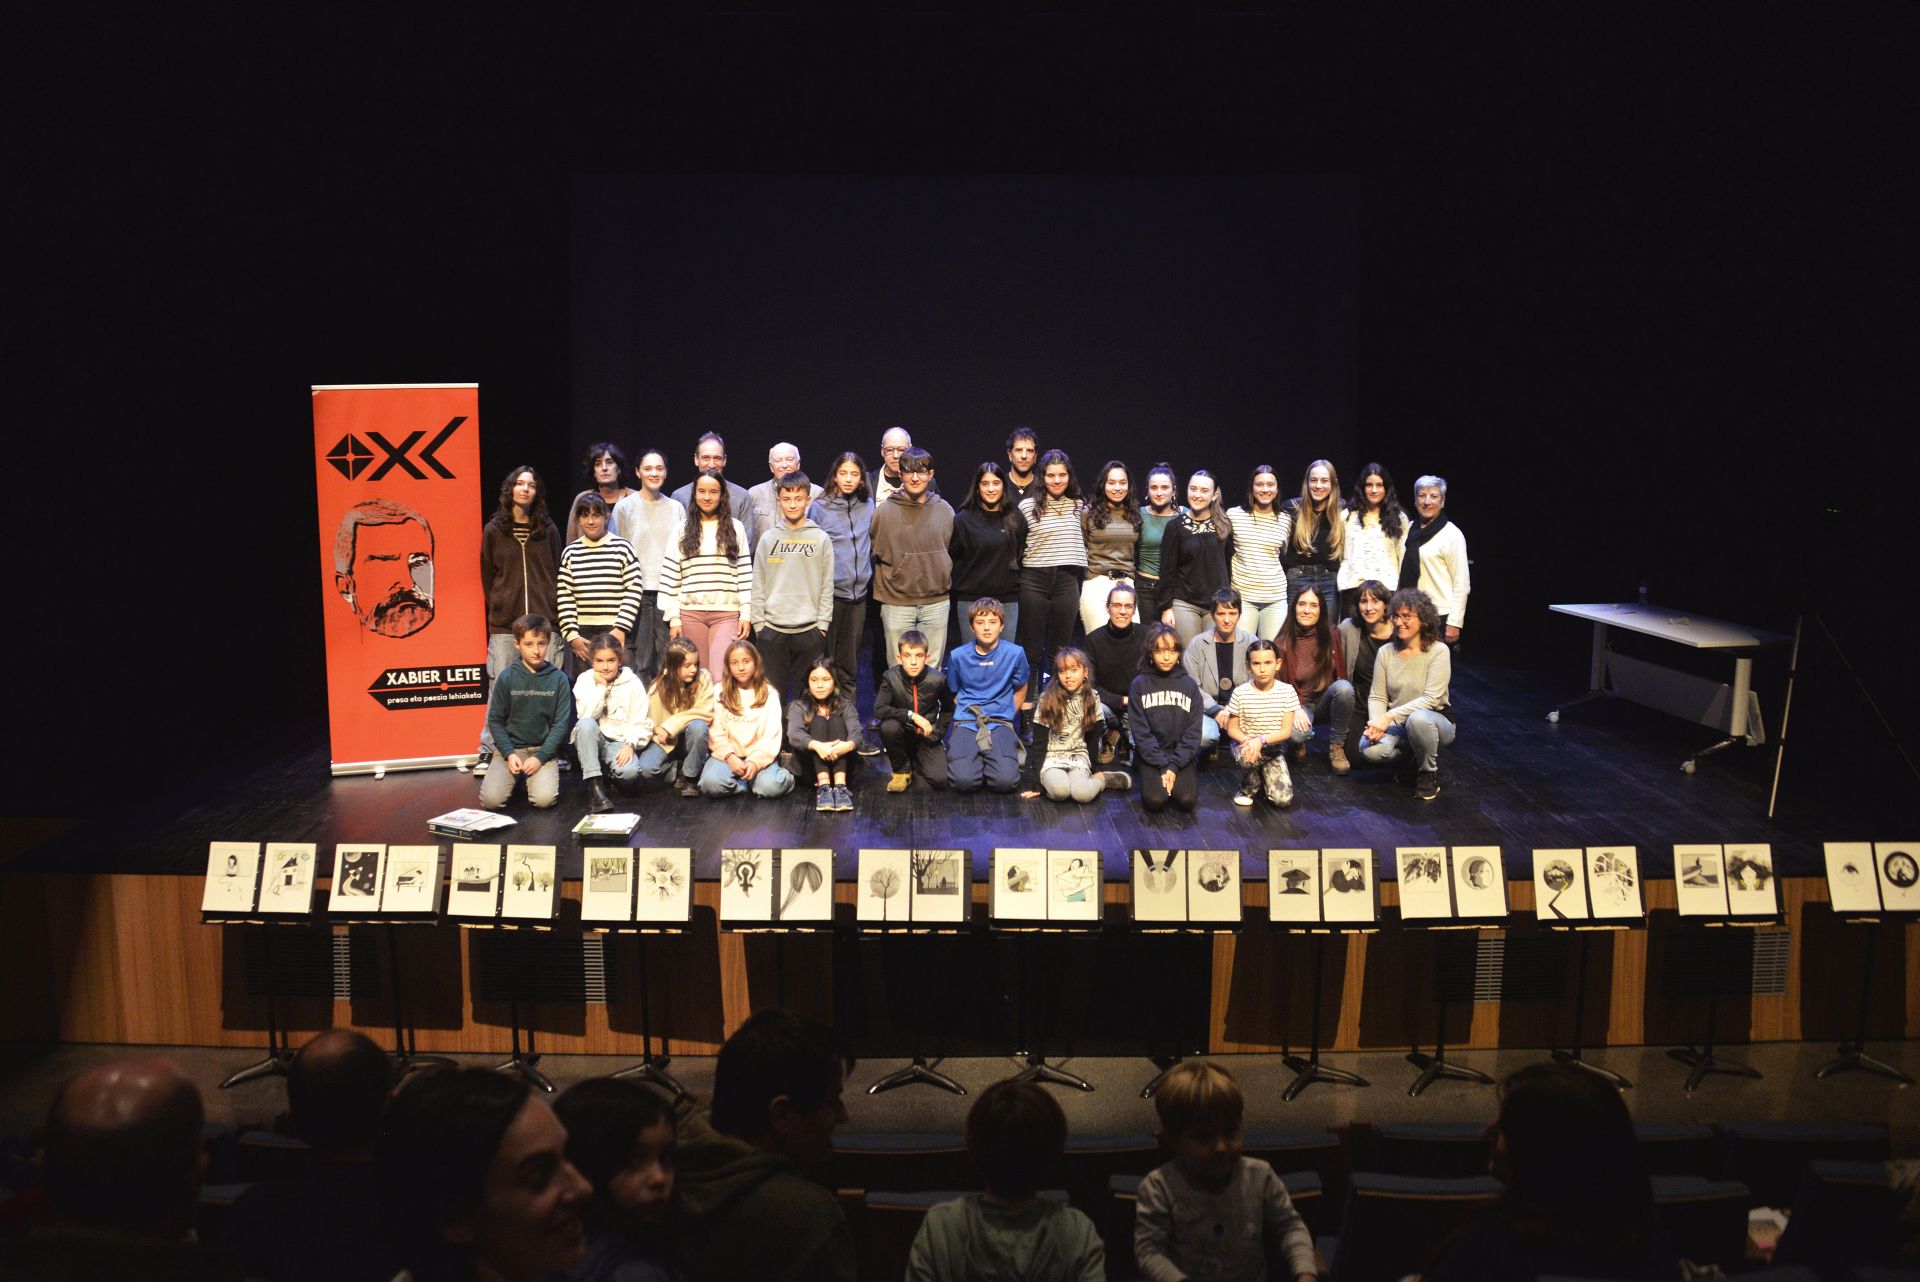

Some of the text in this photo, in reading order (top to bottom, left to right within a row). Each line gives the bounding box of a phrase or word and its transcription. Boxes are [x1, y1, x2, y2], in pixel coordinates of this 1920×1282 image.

[768, 539, 817, 557] LAKERS
[386, 668, 481, 685] XABIER LETE
[424, 694, 447, 703] poesia
[449, 692, 482, 700] lehiaketa
